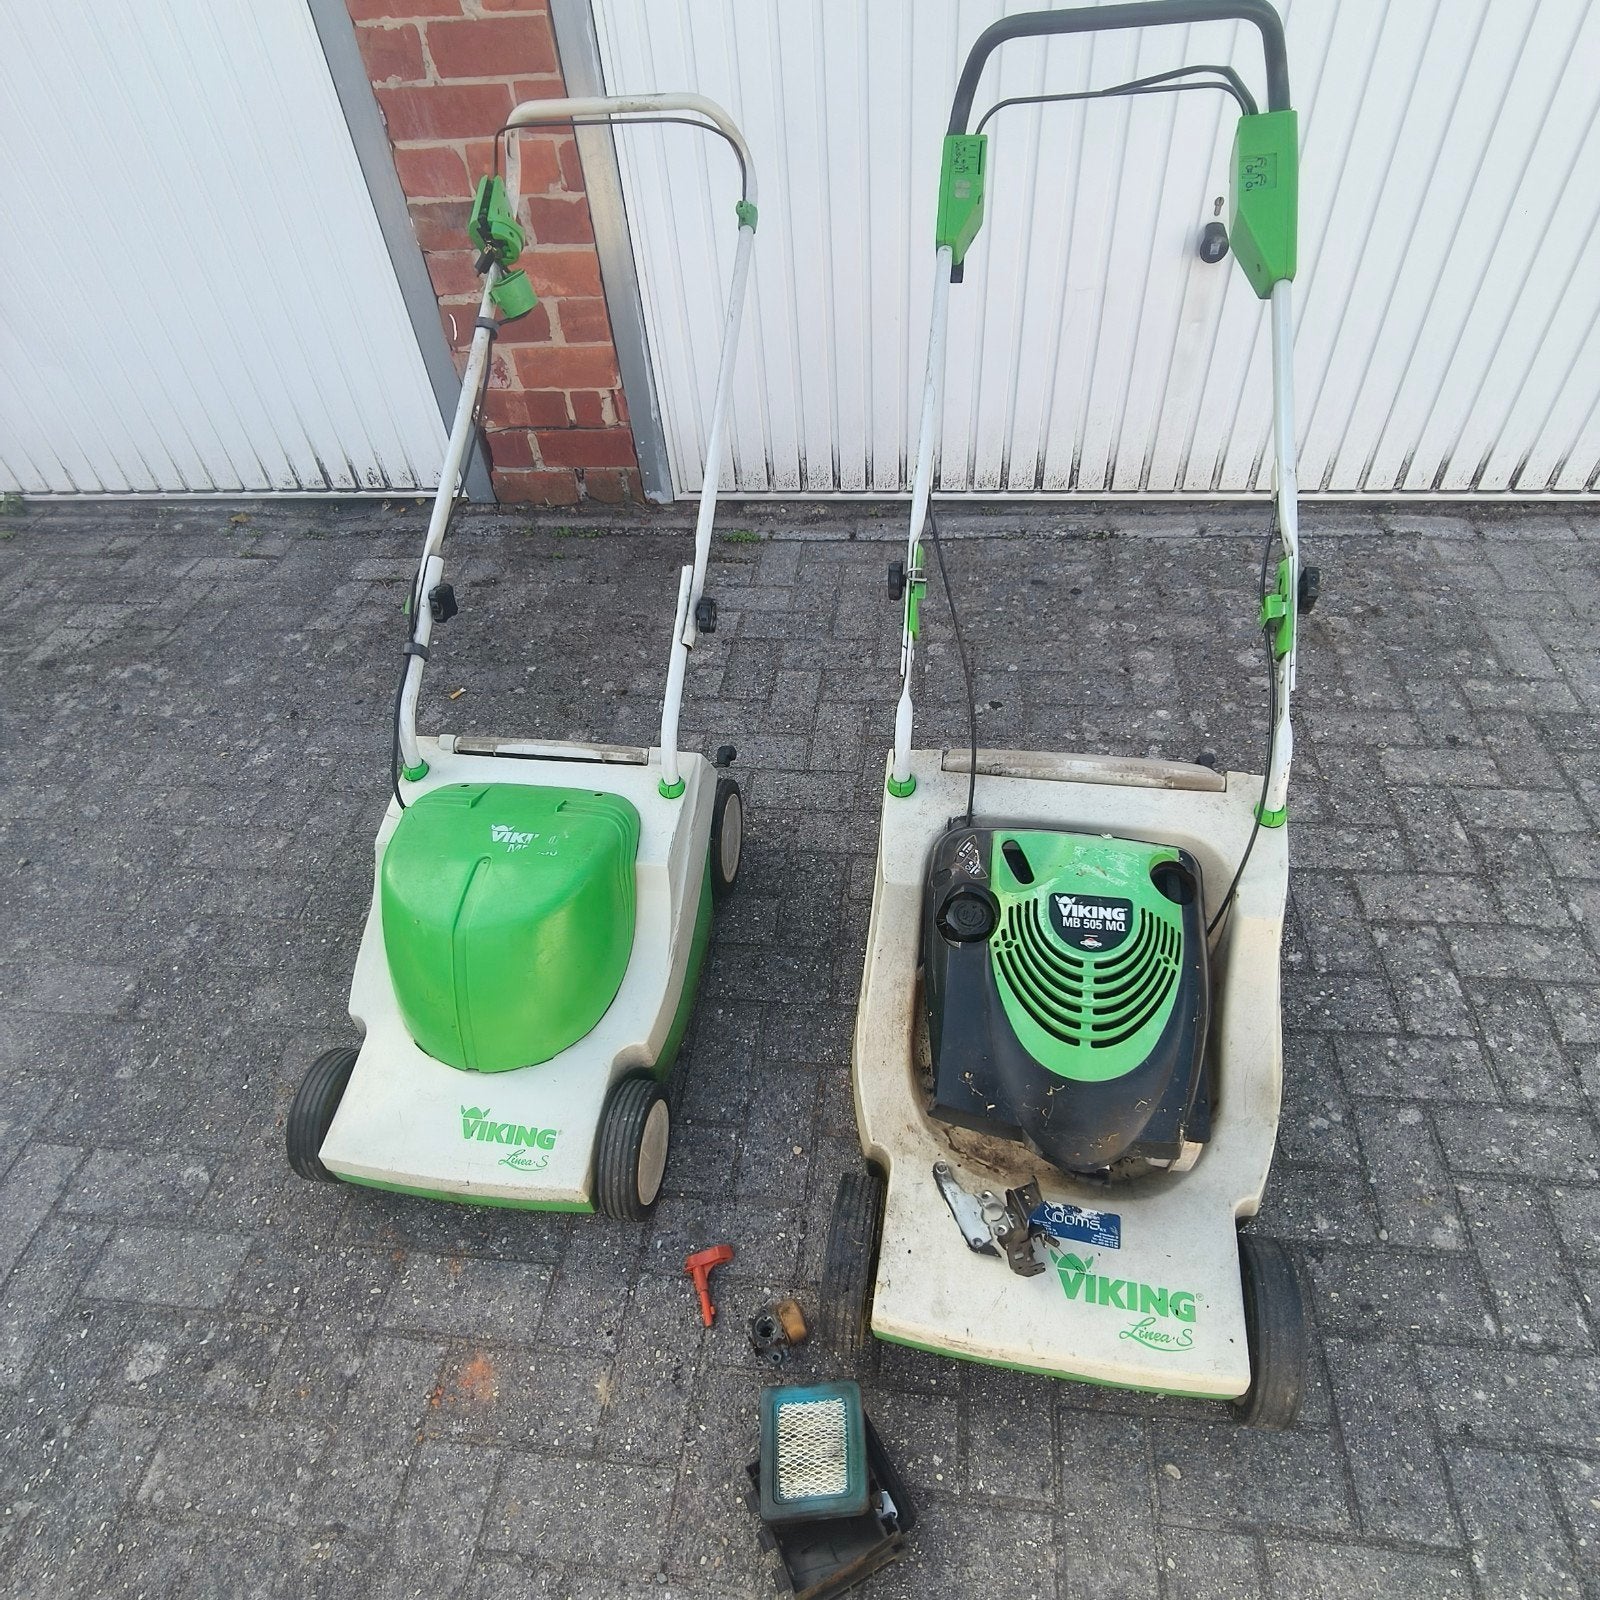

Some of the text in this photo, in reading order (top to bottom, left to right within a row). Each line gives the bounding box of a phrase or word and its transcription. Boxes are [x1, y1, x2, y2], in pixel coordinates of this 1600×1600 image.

[1058, 903, 1126, 921] VIKING
[1062, 916, 1126, 932] MB 505 MQ
[463, 1118, 558, 1151] VIKING
[1057, 1268, 1197, 1323] VIKING
